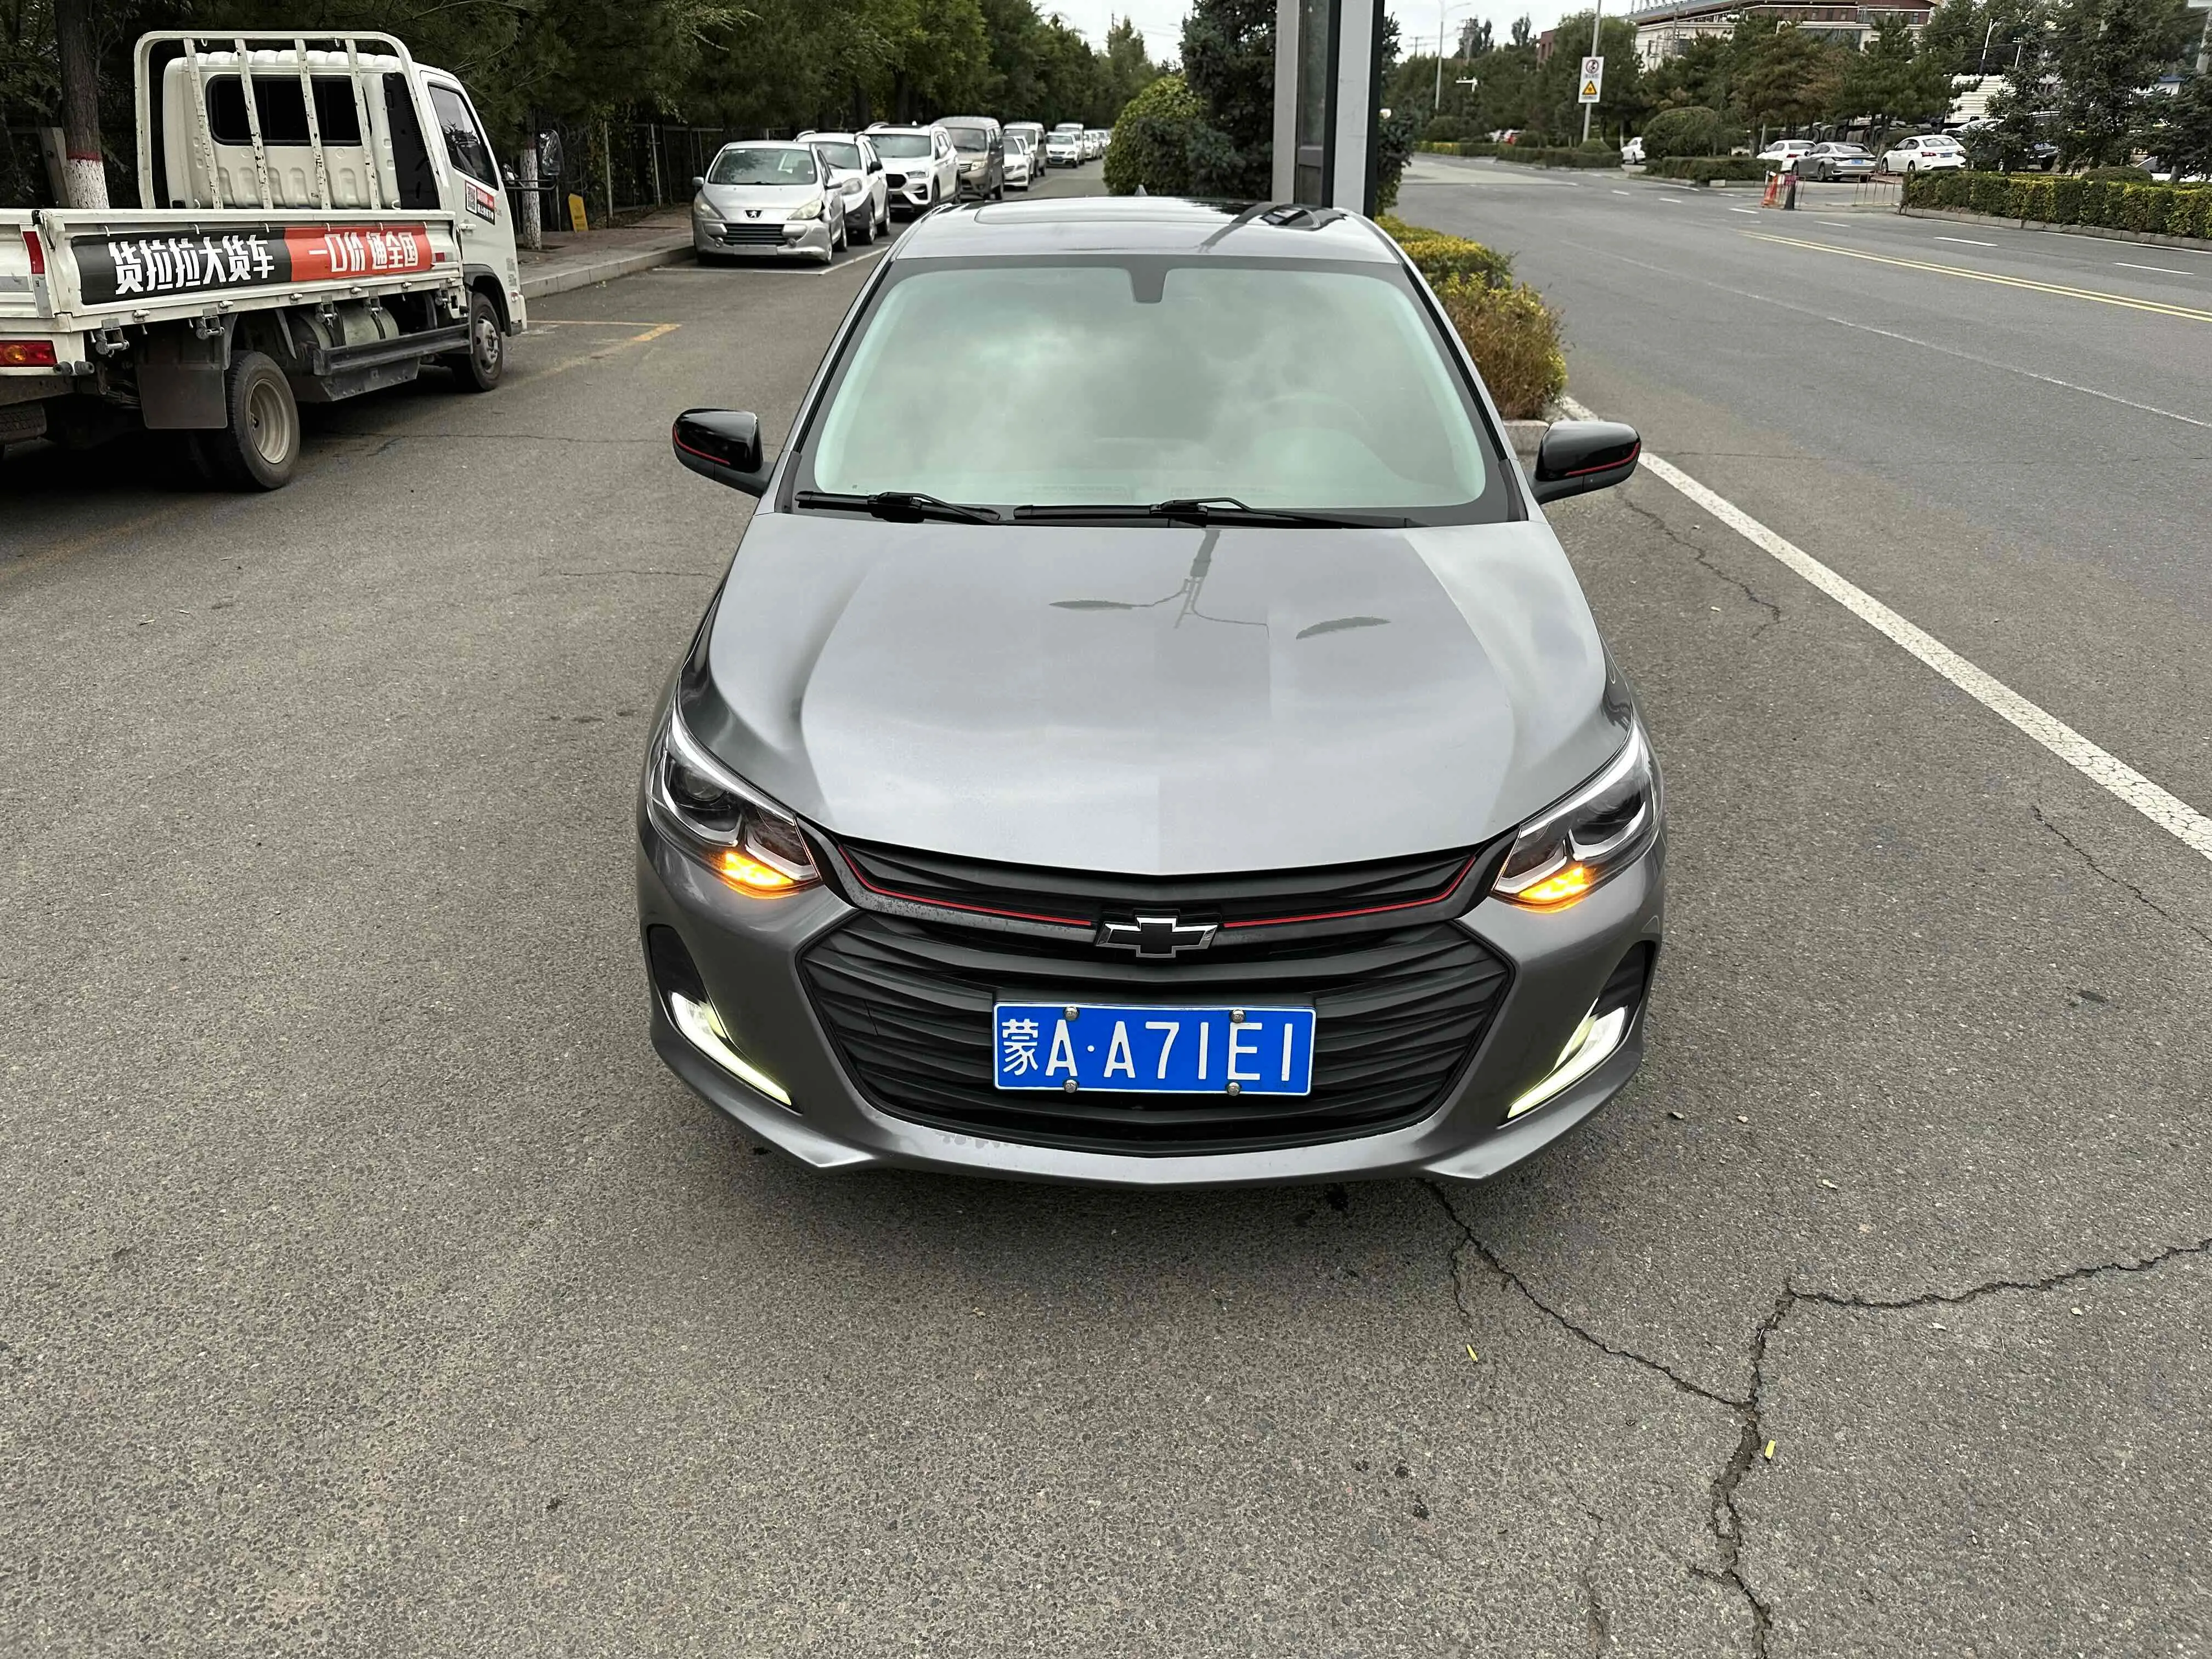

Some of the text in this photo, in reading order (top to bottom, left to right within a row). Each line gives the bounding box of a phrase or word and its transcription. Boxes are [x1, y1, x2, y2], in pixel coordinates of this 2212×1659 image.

[109, 235, 274, 295] 货拉拉大货车
